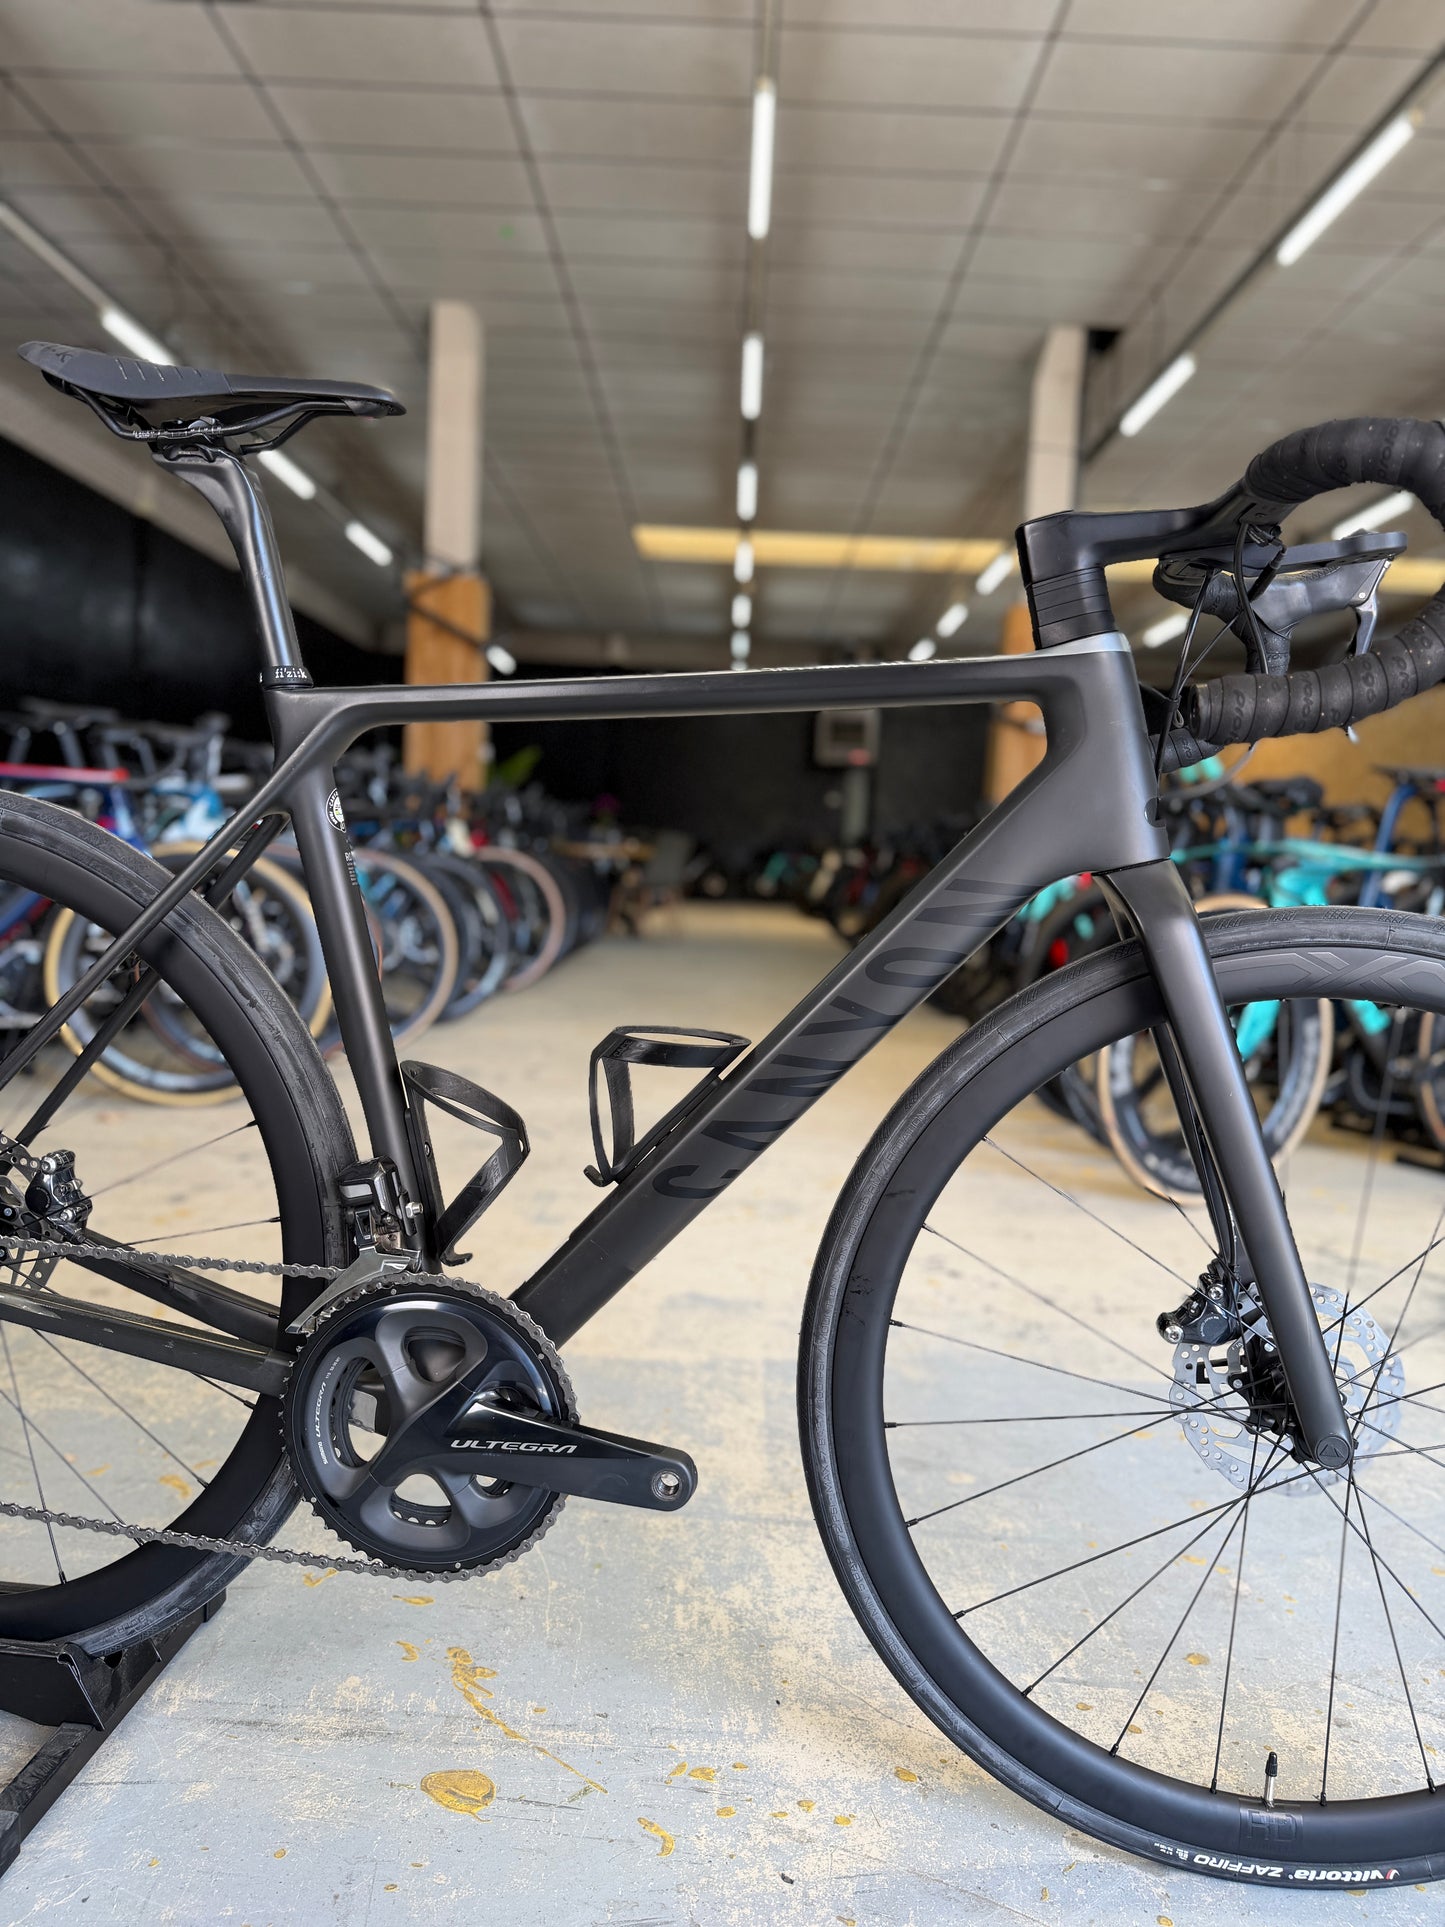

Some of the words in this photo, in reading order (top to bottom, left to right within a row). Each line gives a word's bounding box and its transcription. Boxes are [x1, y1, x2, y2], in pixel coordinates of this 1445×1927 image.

[652, 879, 1046, 1199] CANYON
[314, 1381, 327, 1438] ULTEGRA
[450, 1439, 578, 1454] ULTEGRA
[1193, 1854, 1284, 1878] ZAFFIRO
[1293, 1868, 1385, 1882] vittoria
